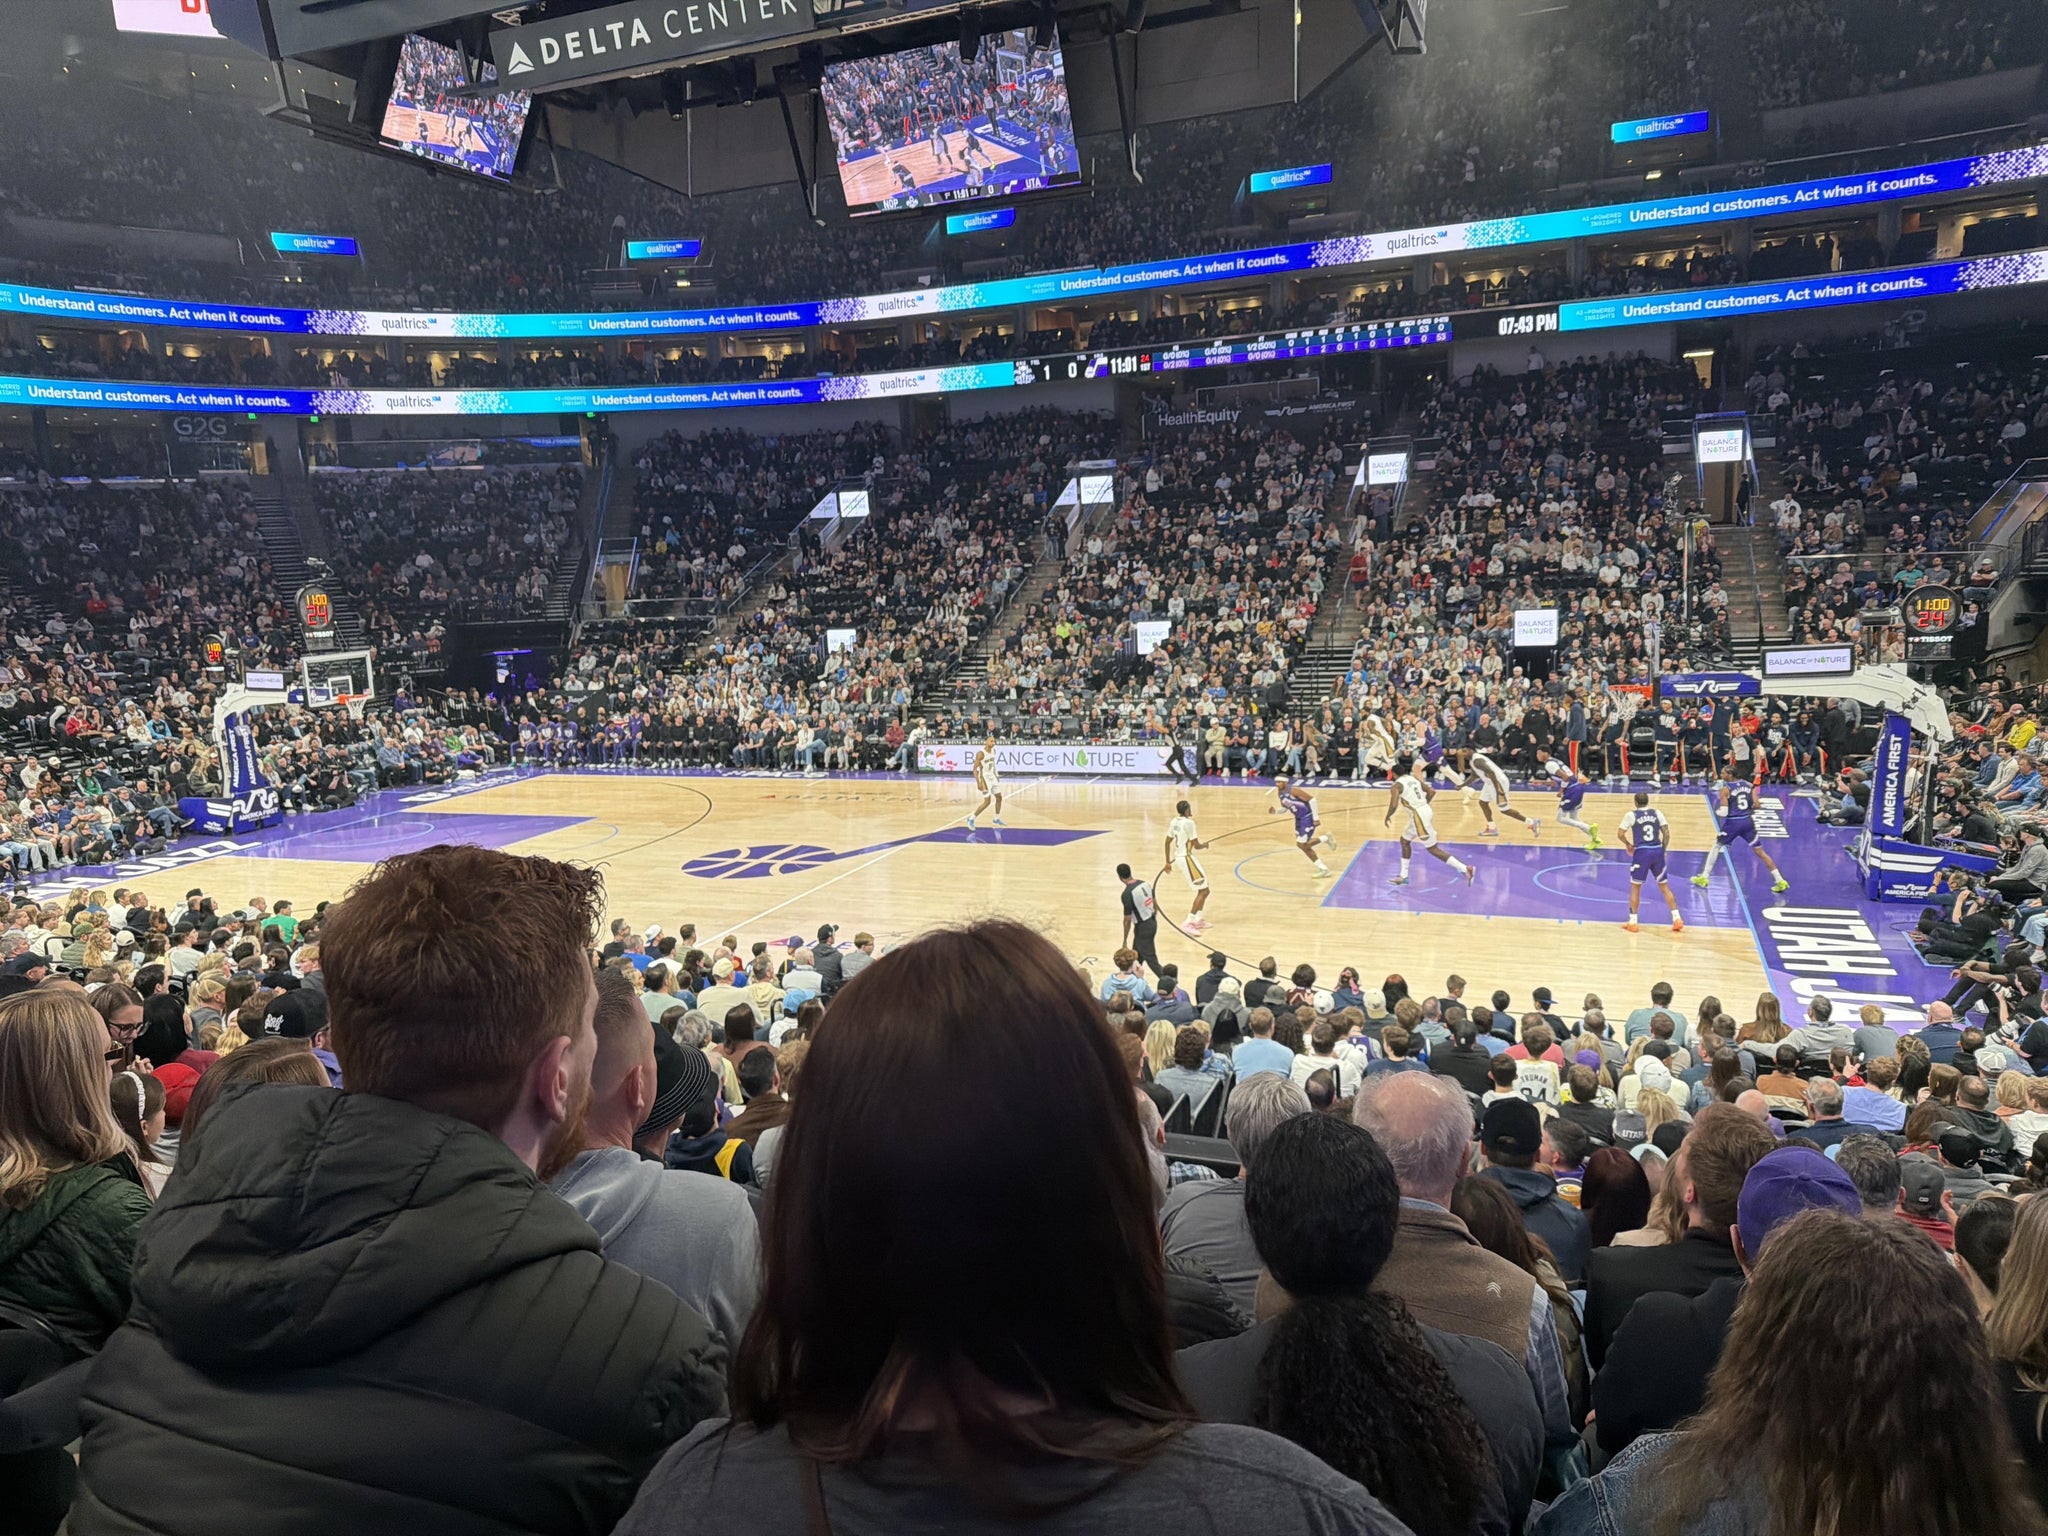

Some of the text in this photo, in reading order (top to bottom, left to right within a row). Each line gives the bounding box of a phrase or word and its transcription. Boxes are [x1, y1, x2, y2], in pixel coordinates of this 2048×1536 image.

[540, 0, 798, 65] DELTA CENTER
[883, 200, 899, 209] NOP
[988, 185, 995, 194] 0
[1024, 178, 1042, 188] UTA
[1629, 172, 1939, 223] Understand customers. Act when it counts.
[1061, 272, 1120, 291] Understand
[1123, 264, 1181, 283] customers.
[1184, 263, 1202, 276] Act
[1204, 260, 1235, 275] when
[1236, 258, 1245, 271] it
[1247, 254, 1289, 269] counts.
[1623, 275, 1928, 318] Understand customers. Act when it counts.
[19, 292, 95, 312] Understand
[98, 302, 167, 318] customers.
[169, 307, 191, 320] Act
[193, 309, 226, 322] when
[228, 310, 238, 323] it
[240, 312, 285, 326] counts.
[589, 314, 649, 330] Understand
[651, 316, 706, 329] customers.
[708, 314, 725, 326] Act
[728, 313, 754, 325] when
[756, 312, 763, 324] it
[765, 311, 800, 323] counts.
[1498, 314, 1558, 336] 07:43 PM
[1044, 354, 1150, 381] 1 0 11:01 24
[1140, 363, 1150, 372] 1ST
[28, 385, 102, 402] Understand
[106, 389, 174, 405] customers.
[176, 392, 197, 405] Act
[198, 393, 232, 406] when
[234, 394, 244, 406] it
[246, 395, 291, 408] counts.
[592, 391, 652, 406] Understand
[655, 391, 710, 404] customers.
[712, 390, 729, 402] Act
[730, 389, 757, 401] when
[758, 388, 765, 399] it
[767, 387, 803, 399] counts.
[174, 416, 227, 435] G2G
[1158, 408, 1241, 427] HealthEquity
[1703, 438, 1739, 447] BALANCE
[1707, 446, 1739, 454] NATURE
[306, 594, 328, 606] 11:00
[1917, 598, 1950, 611] 11:00
[307, 606, 329, 626] 24
[1918, 611, 1945, 628] 24
[1920, 635, 1954, 643] TISSOT
[207, 644, 222, 652] 11:00
[208, 652, 221, 662] 24
[1768, 656, 1807, 666] BALANCE
[1814, 656, 1847, 664] NATURE
[228, 728, 237, 753] FIRST
[964, 751, 1044, 766] BANCE
[1047, 754, 1060, 764] OF
[246, 750, 257, 785] AMERICA
[1883, 734, 1902, 827] AMERICA FIRST
[1414, 786, 1422, 800] 6
[1738, 794, 1749, 810] 5
[239, 810, 262, 821] AMERICA
[263, 807, 278, 817] FIRST
[1637, 814, 1657, 825] GEORGE
[1643, 825, 1654, 842] 3
[1885, 888, 1911, 897] AMERICA
[1762, 907, 1898, 976] UTAH
[1520, 1074, 1549, 1085] TRUMAN
[1622, 1129, 1644, 1139] UTAH
